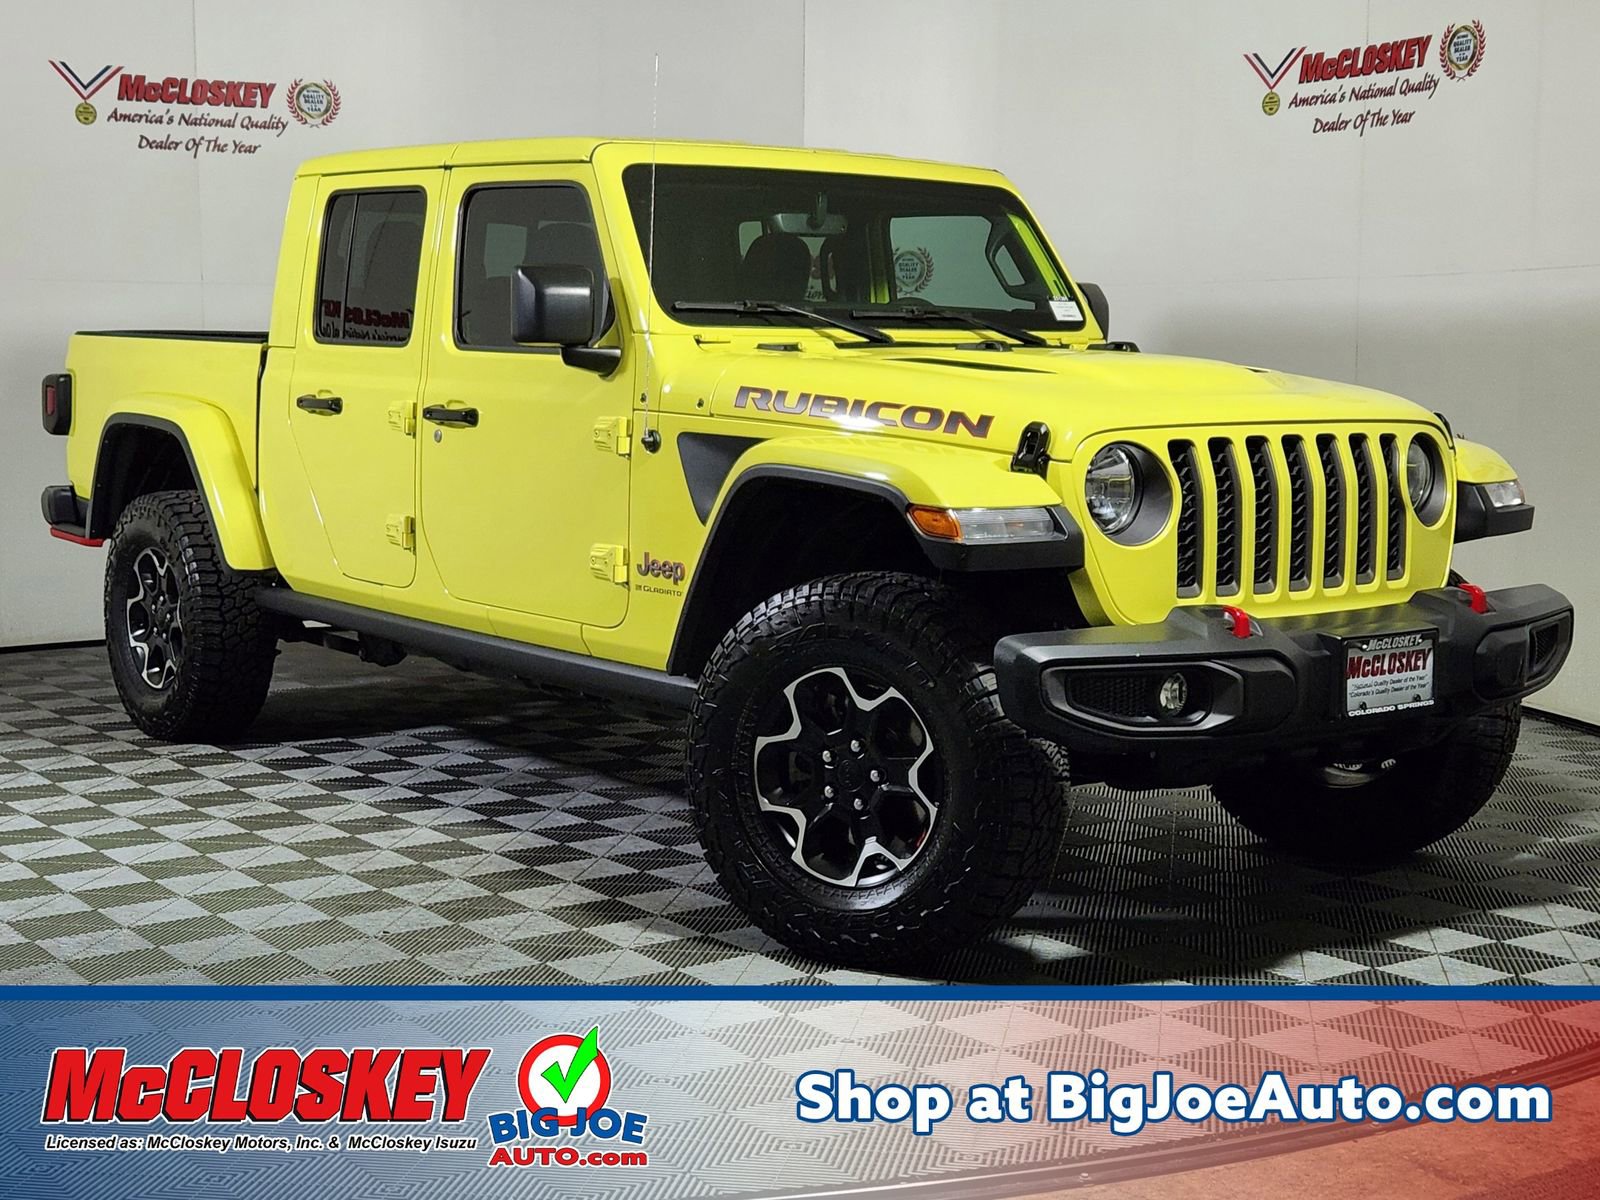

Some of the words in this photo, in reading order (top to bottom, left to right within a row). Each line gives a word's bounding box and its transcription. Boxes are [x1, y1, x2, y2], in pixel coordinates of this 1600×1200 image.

[1298, 34, 1433, 84] McCLOSKEY
[117, 73, 276, 109] McCLOSKEY
[1288, 85, 1346, 109] America's
[1349, 77, 1396, 101] National
[1399, 72, 1440, 100] Quality
[107, 107, 174, 126] America's
[178, 112, 237, 130] National
[240, 114, 289, 137] Quality
[1312, 111, 1352, 134] Dealer
[1354, 109, 1371, 137] Of
[1369, 108, 1389, 127] The
[1390, 110, 1416, 126] Year
[137, 134, 182, 152] Dealer
[185, 135, 203, 158] Of
[204, 136, 228, 153] The
[232, 139, 261, 155] Year
[734, 385, 996, 439] RUBICON
[636, 551, 686, 586] Jeep
[643, 586, 684, 597] GLADIATO
[1366, 634, 1421, 651] McCLOSKEY
[1344, 648, 1432, 679] McCLOSKEY
[1348, 705, 1396, 716] COLORADO
[1397, 700, 1434, 710] SPRINGS
